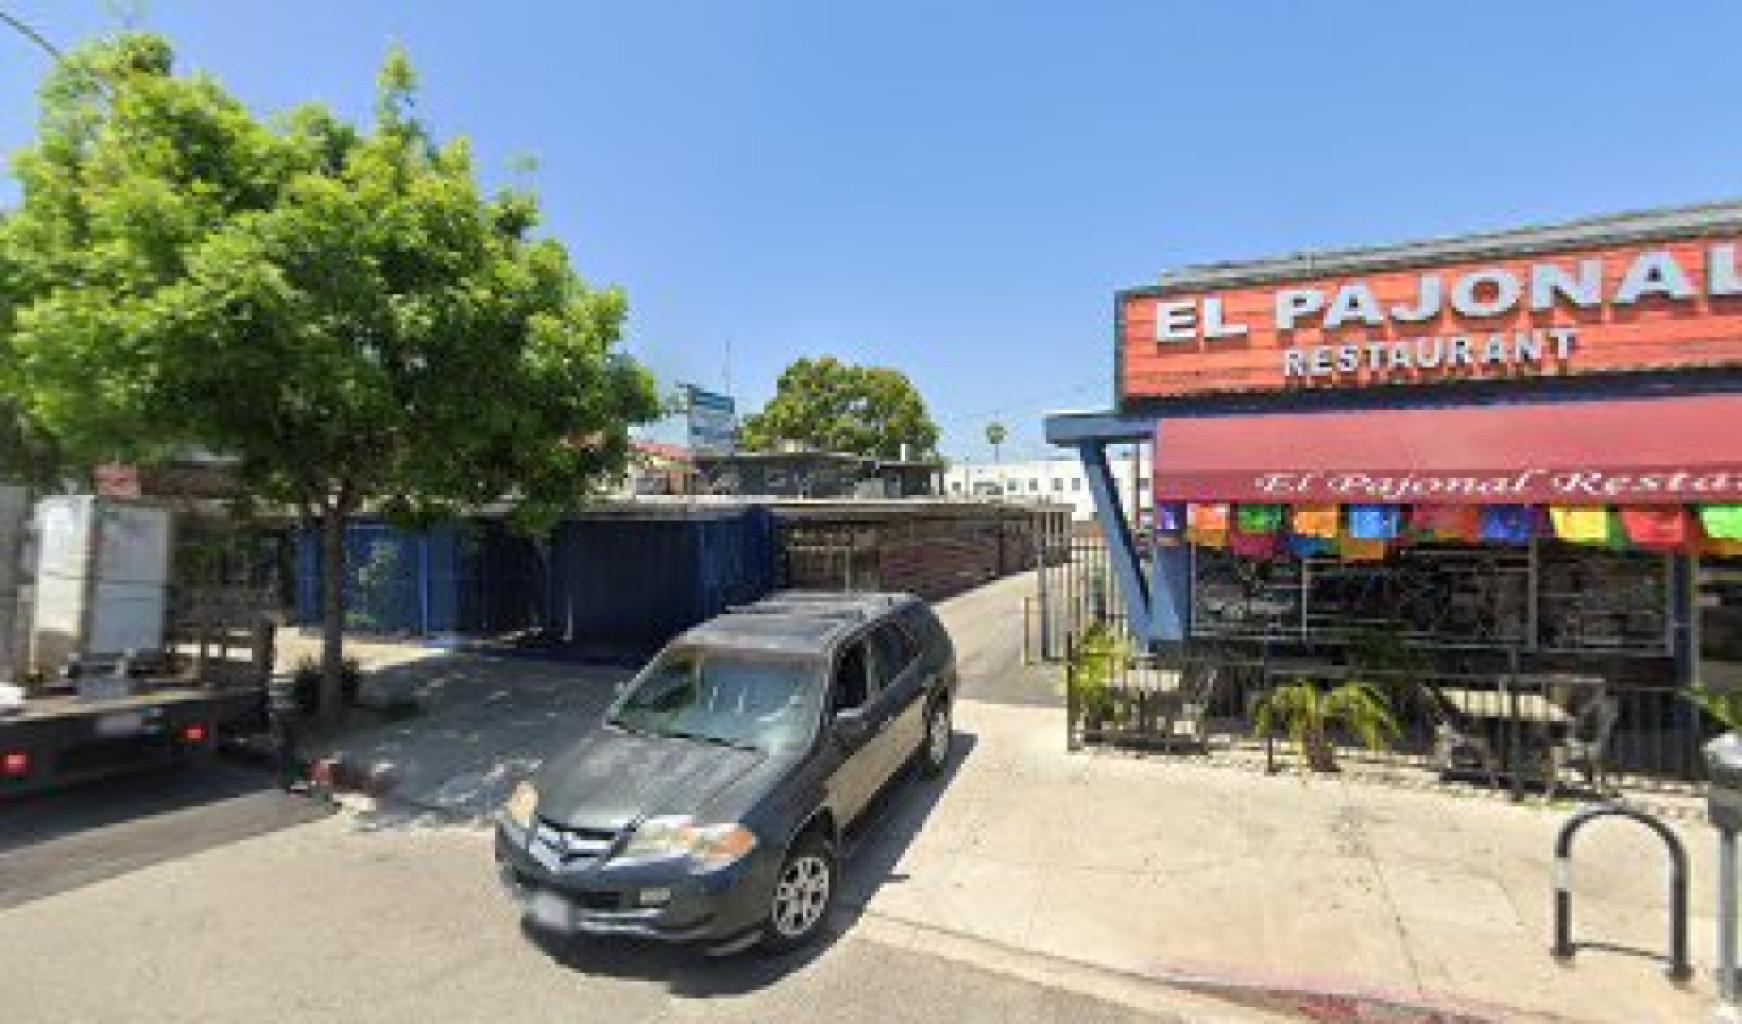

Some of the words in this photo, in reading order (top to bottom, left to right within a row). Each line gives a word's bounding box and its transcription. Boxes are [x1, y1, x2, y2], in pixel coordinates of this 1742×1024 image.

[1156, 298, 1248, 342] EL
[1275, 243, 1742, 329] PAJONAL
[1285, 327, 1578, 376] RESTAURANT
[1255, 472, 1318, 494] El
[1326, 469, 1546, 499] Pajonal
[1549, 470, 1742, 496] Resta
